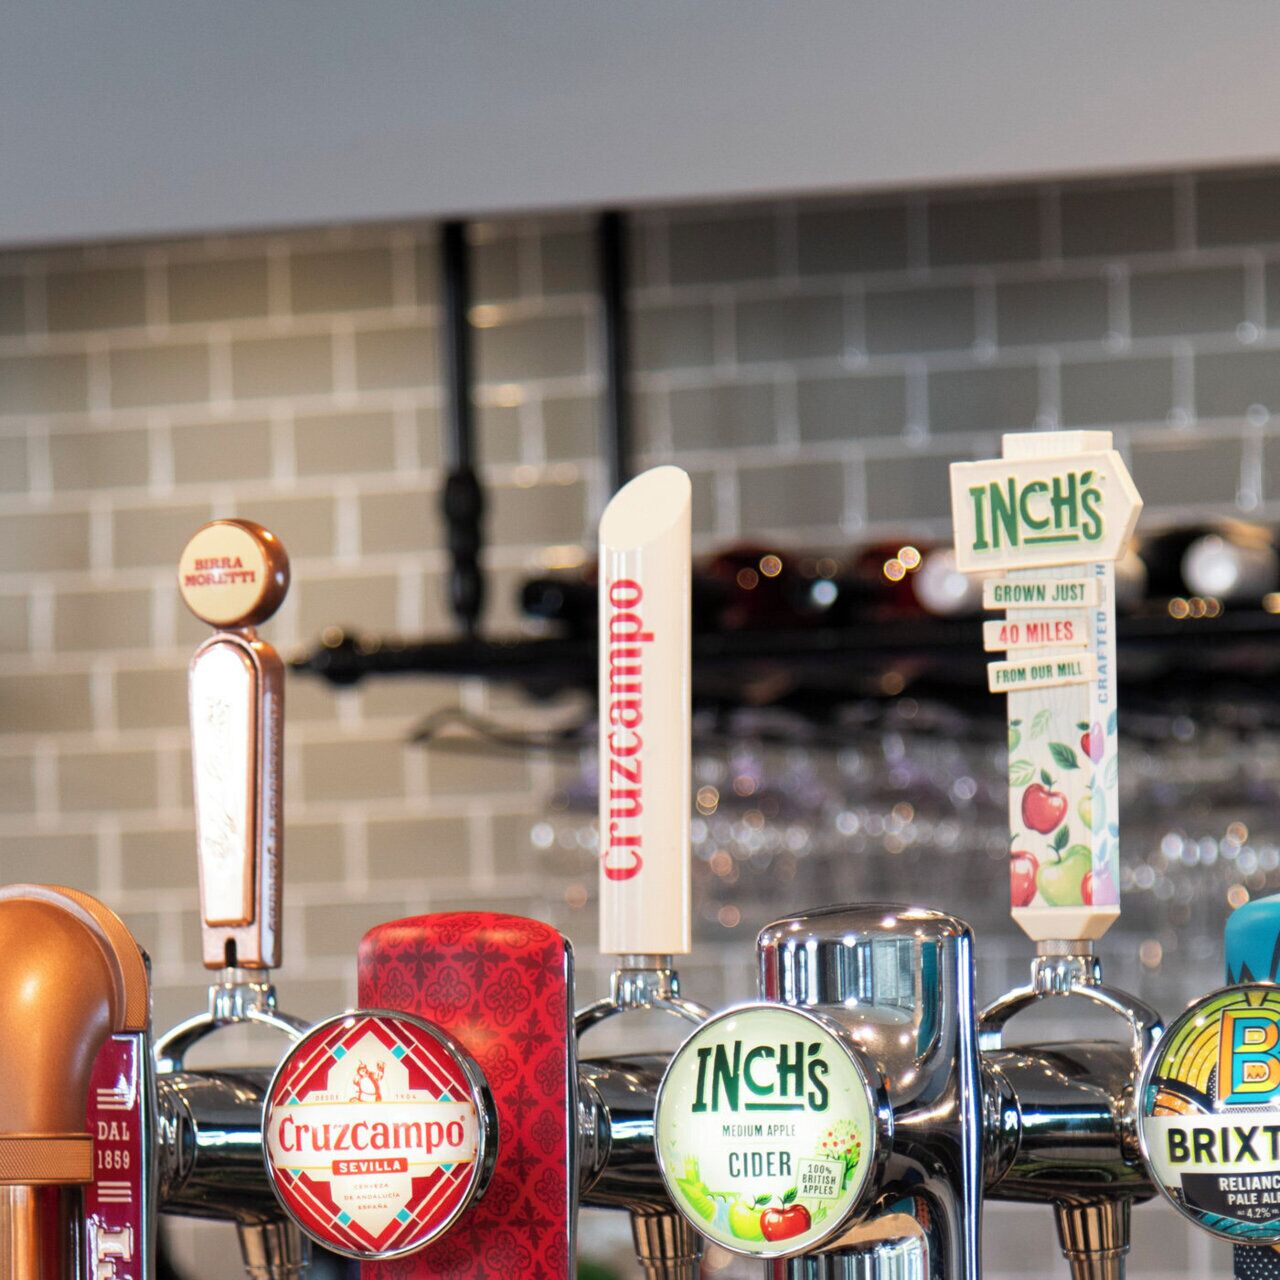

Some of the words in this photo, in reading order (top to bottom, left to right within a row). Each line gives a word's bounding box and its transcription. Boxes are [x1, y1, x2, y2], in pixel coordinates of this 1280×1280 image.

[194, 556, 243, 570] BIRRA
[994, 584, 1046, 602] GROWN
[1052, 583, 1086, 601] JUST
[999, 624, 1020, 644] 40
[1026, 621, 1074, 643] MILES
[1096, 611, 1108, 704] CRAFTED
[996, 667, 1026, 684] FROM
[1031, 665, 1053, 679] OUR
[1058, 661, 1083, 677] MILL
[602, 578, 655, 881] Cruzcampo
[97, 1121, 130, 1142] DAL
[278, 1114, 465, 1154] Cruzcampo
[722, 1124, 763, 1137] MEDIUM
[767, 1124, 796, 1137] APPLE
[97, 1150, 130, 1169] 1859
[339, 1160, 401, 1173] SEVILLA
[728, 1151, 792, 1178] CIDER
[802, 1173, 836, 1185] BRITISH
[808, 1164, 832, 1175] 100%
[803, 1184, 834, 1195] APPLES
[1227, 1193, 1259, 1206] PALE
[1246, 1207, 1272, 1218] 4.2%
